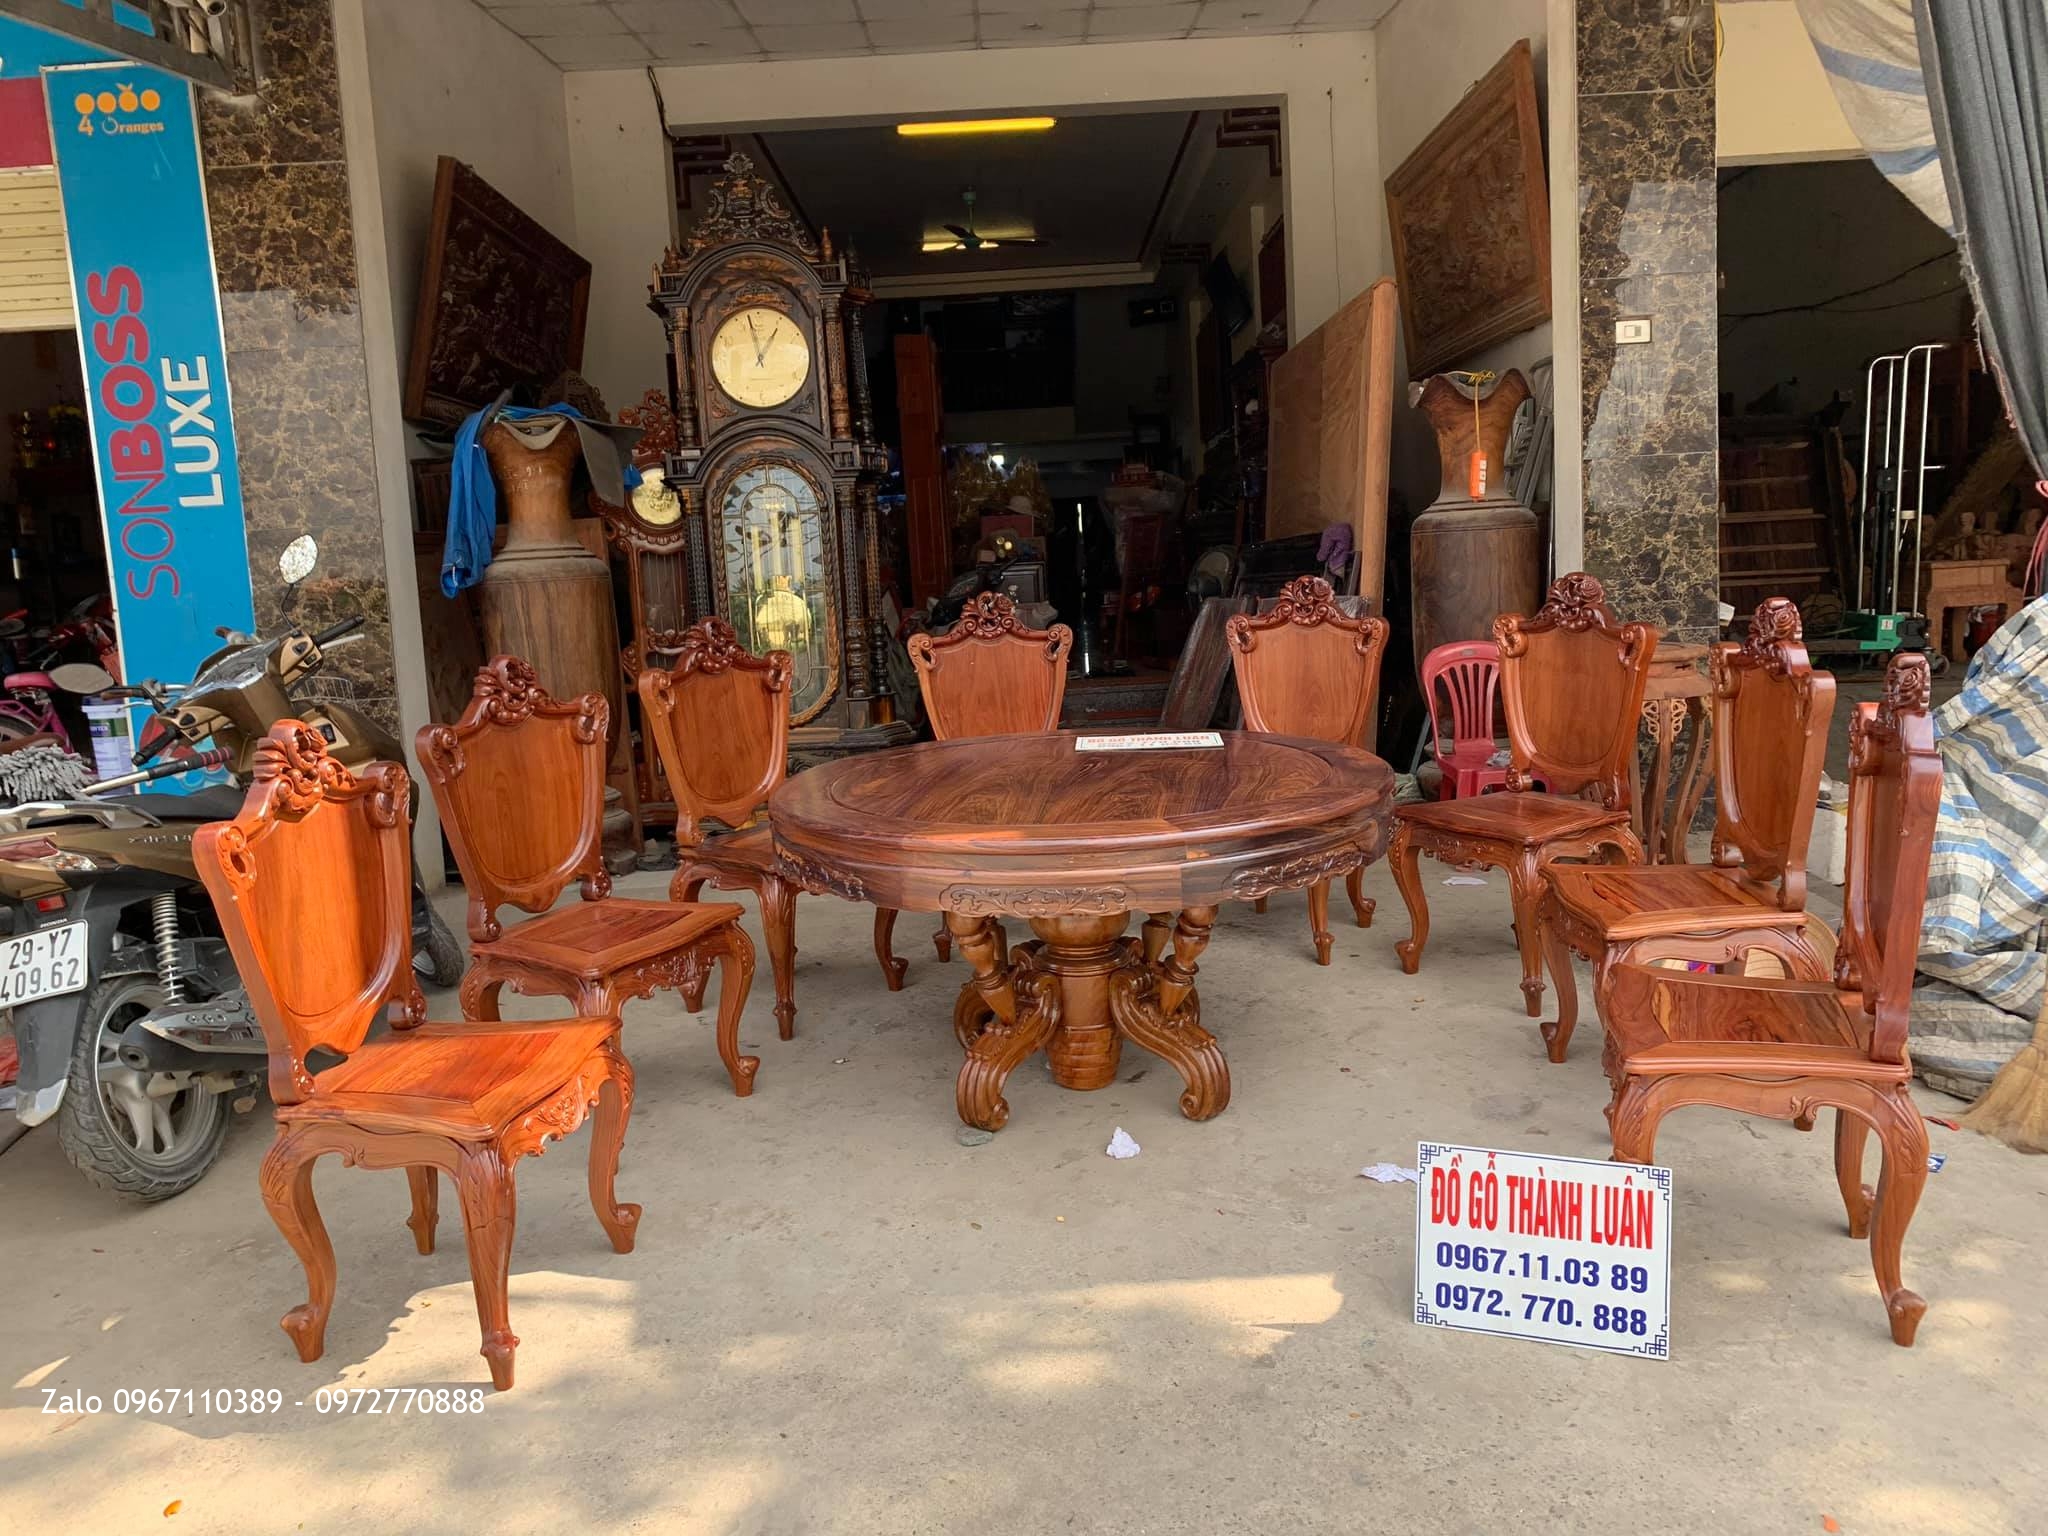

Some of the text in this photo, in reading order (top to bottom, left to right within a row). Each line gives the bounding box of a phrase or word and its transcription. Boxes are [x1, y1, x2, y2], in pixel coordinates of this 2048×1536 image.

[77, 114, 165, 136] 4 Oranges
[160, 354, 225, 508] LUXE
[8, 927, 73, 970] 29-Y7
[0, 957, 79, 1001] 409.62
[1430, 1151, 1654, 1250] ĐỒ GỖ THÀNH LUÂN
[1435, 1241, 1649, 1294] 0967.11.03 89
[1434, 1282, 1648, 1336] 0972. 770. 888
